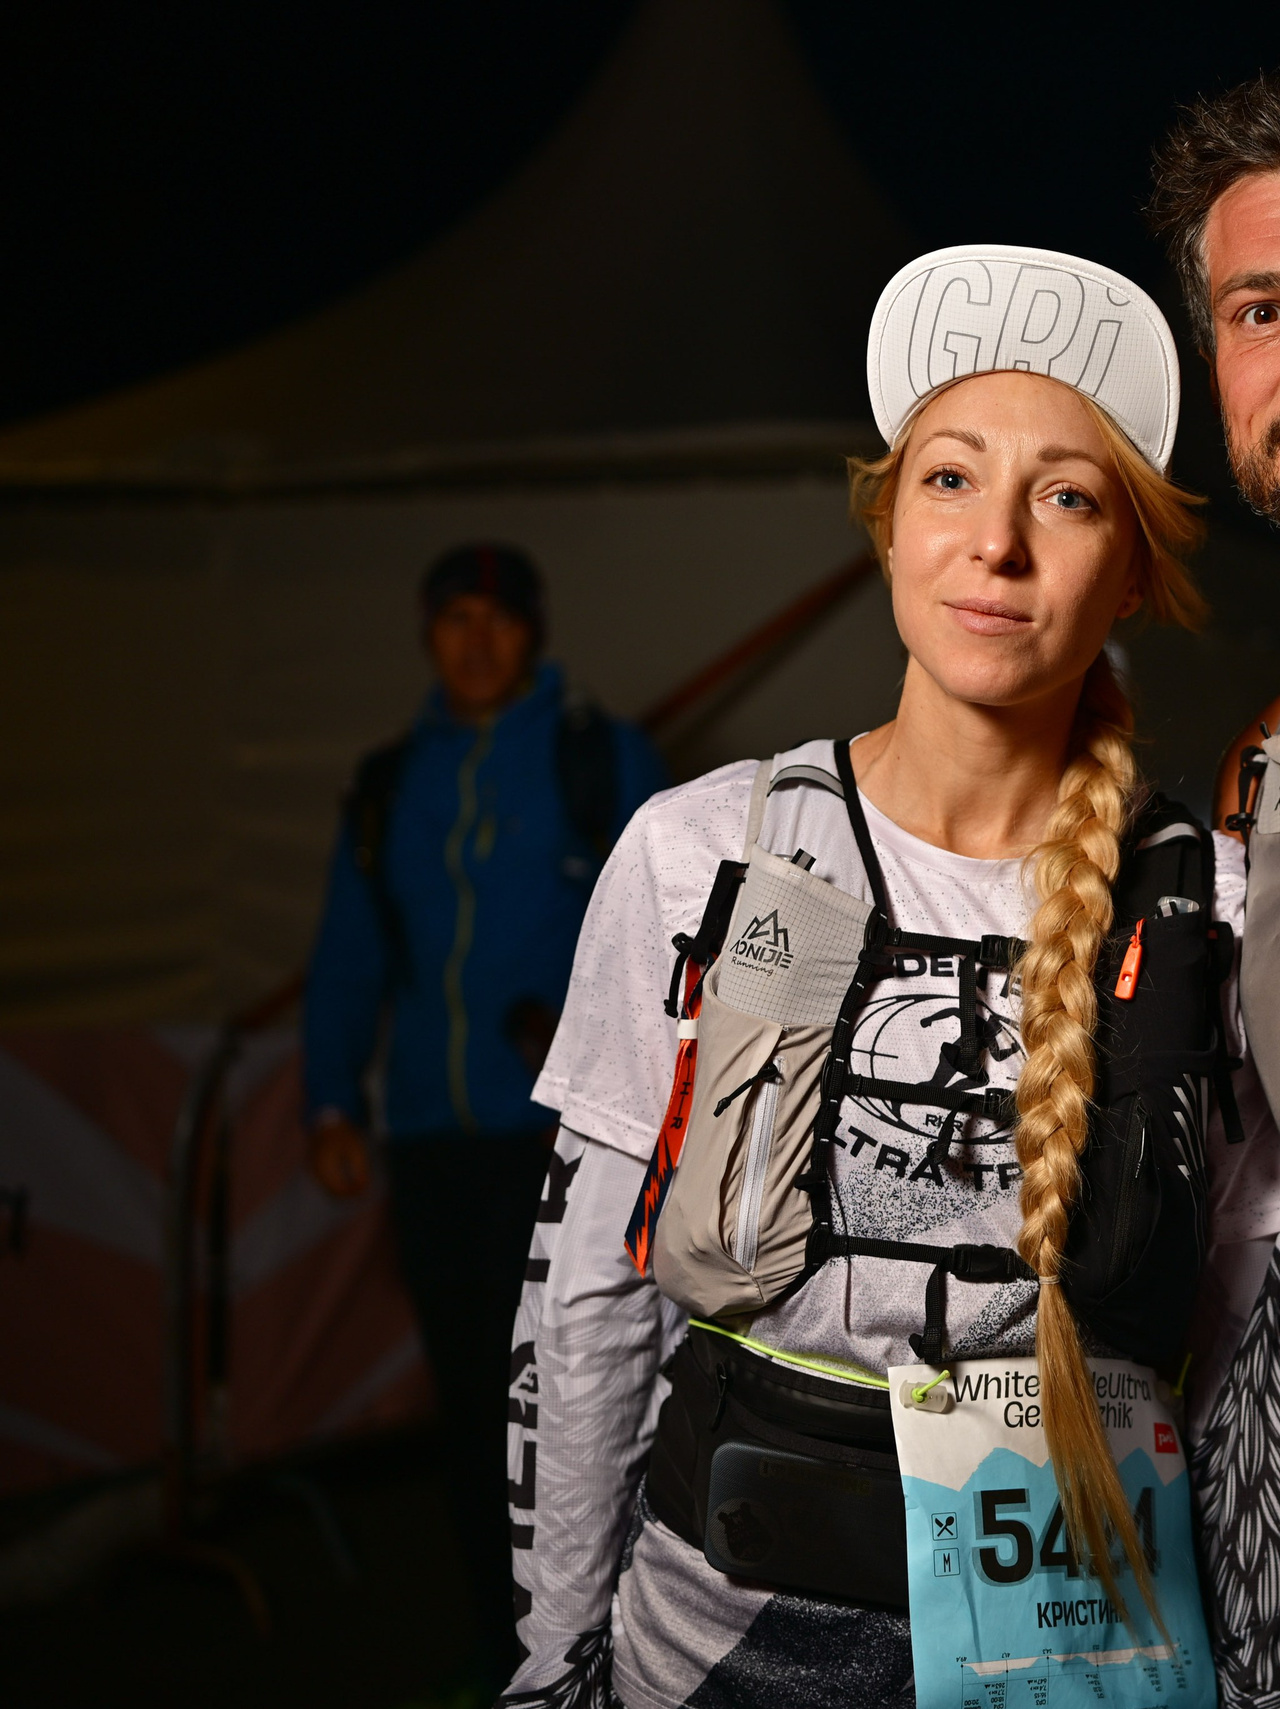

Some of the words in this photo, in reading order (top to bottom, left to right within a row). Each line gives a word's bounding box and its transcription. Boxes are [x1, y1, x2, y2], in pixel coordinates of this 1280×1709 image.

[730, 956, 775, 976] Running
[831, 1116, 945, 1187] LTRA
[1036, 1599, 1126, 1629] КРИСТИН
